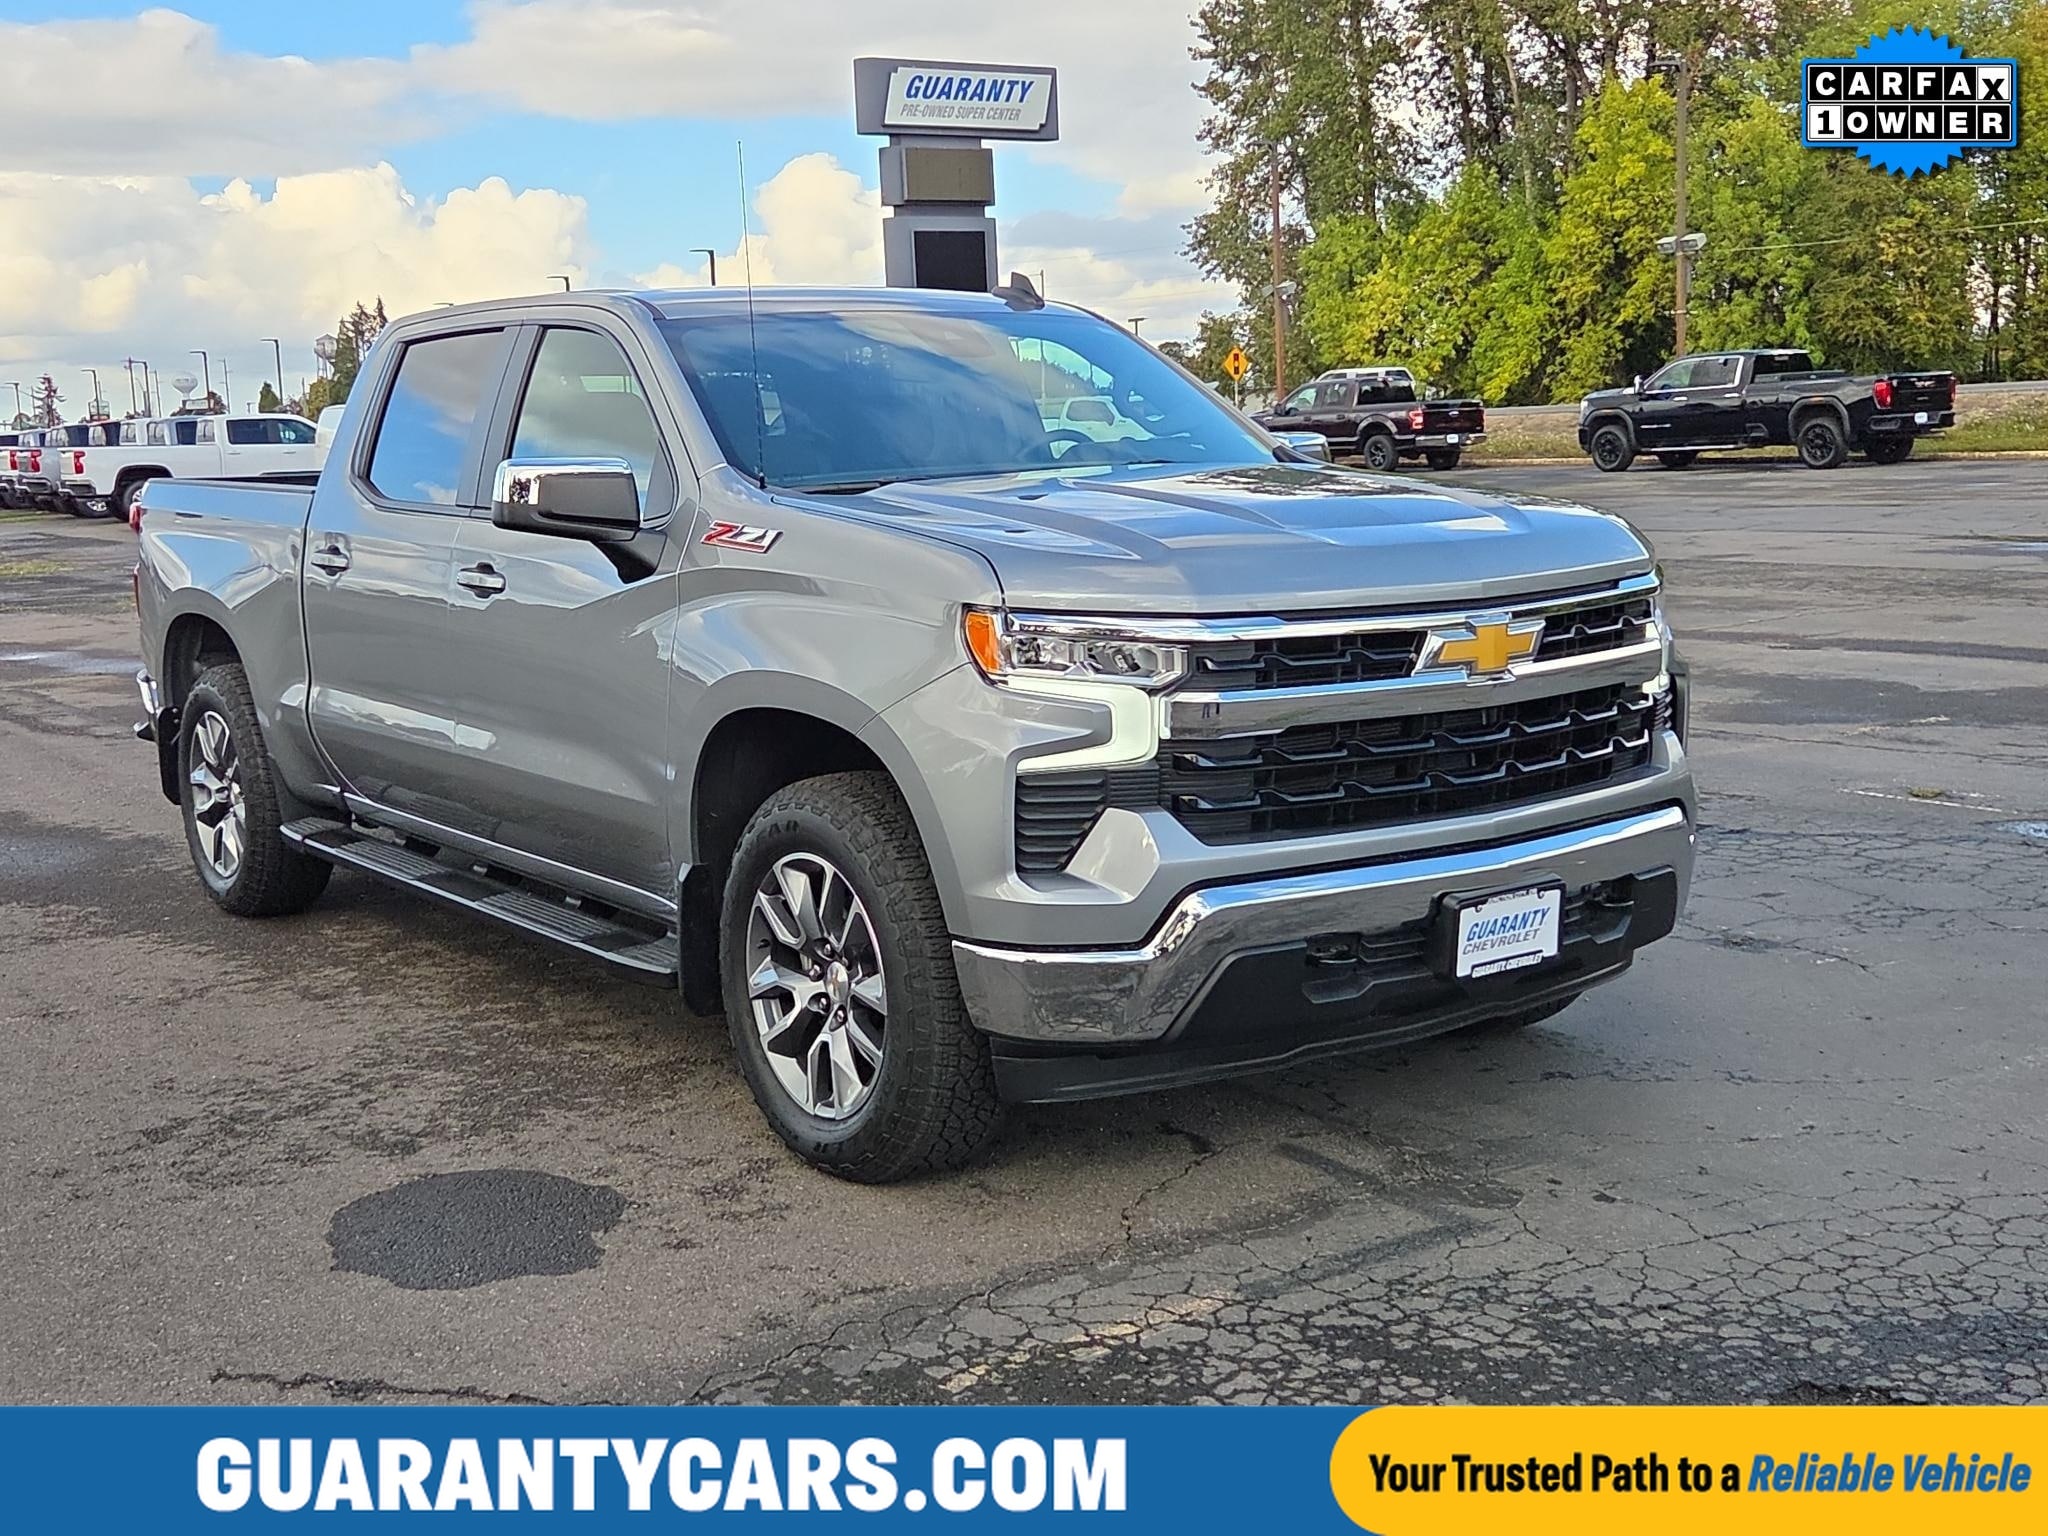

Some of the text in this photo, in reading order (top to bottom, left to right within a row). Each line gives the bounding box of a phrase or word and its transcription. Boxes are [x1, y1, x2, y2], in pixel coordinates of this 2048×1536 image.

[905, 74, 1035, 104] GUARANTY
[900, 103, 1022, 121] PRE-OWNED SUPER CENTER
[1466, 907, 1551, 942] GUARANTY
[1462, 928, 1540, 955] CHEVROLET
